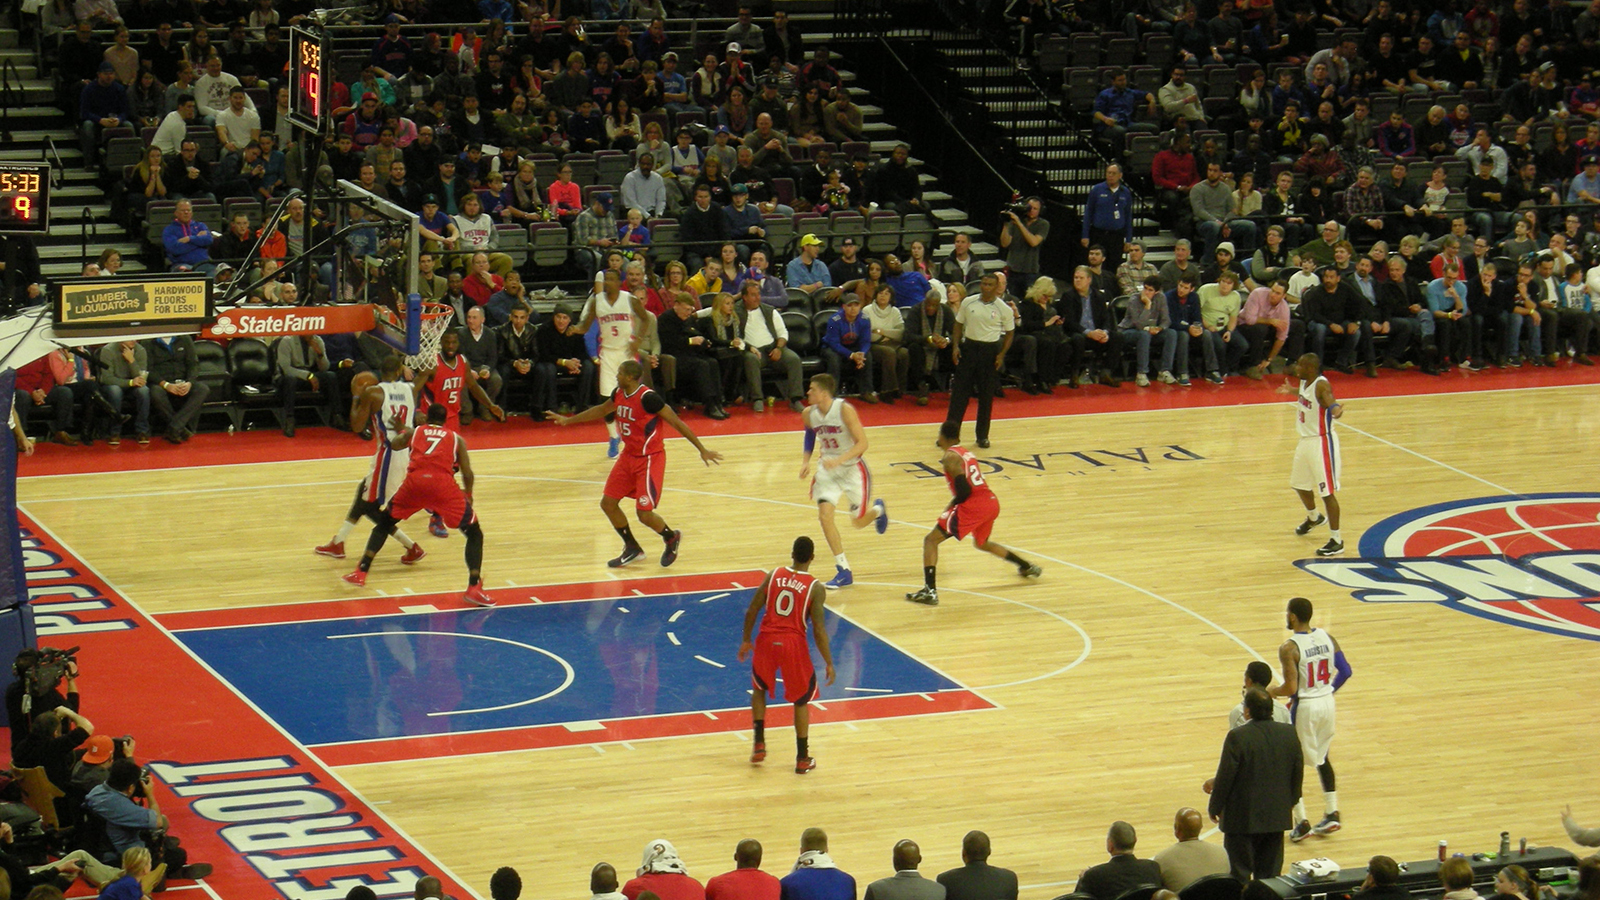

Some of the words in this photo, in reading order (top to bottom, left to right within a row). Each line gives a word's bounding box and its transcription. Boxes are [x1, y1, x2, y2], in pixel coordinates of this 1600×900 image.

[1, 173, 40, 193] 5:33
[15, 196, 31, 219] 9
[154, 285, 203, 295] HARDWOOD
[86, 291, 128, 304] LUMBER
[154, 296, 187, 305] FLOORS
[154, 305, 171, 314] FOR
[173, 304, 197, 313] LESS!
[611, 326, 619, 337] 5
[448, 391, 458, 404] 5
[425, 437, 442, 455] 7
[1319, 481, 1326, 492] P
[776, 577, 807, 594] TEAGUE
[775, 589, 795, 617] 0
[1307, 658, 1331, 688] 14
